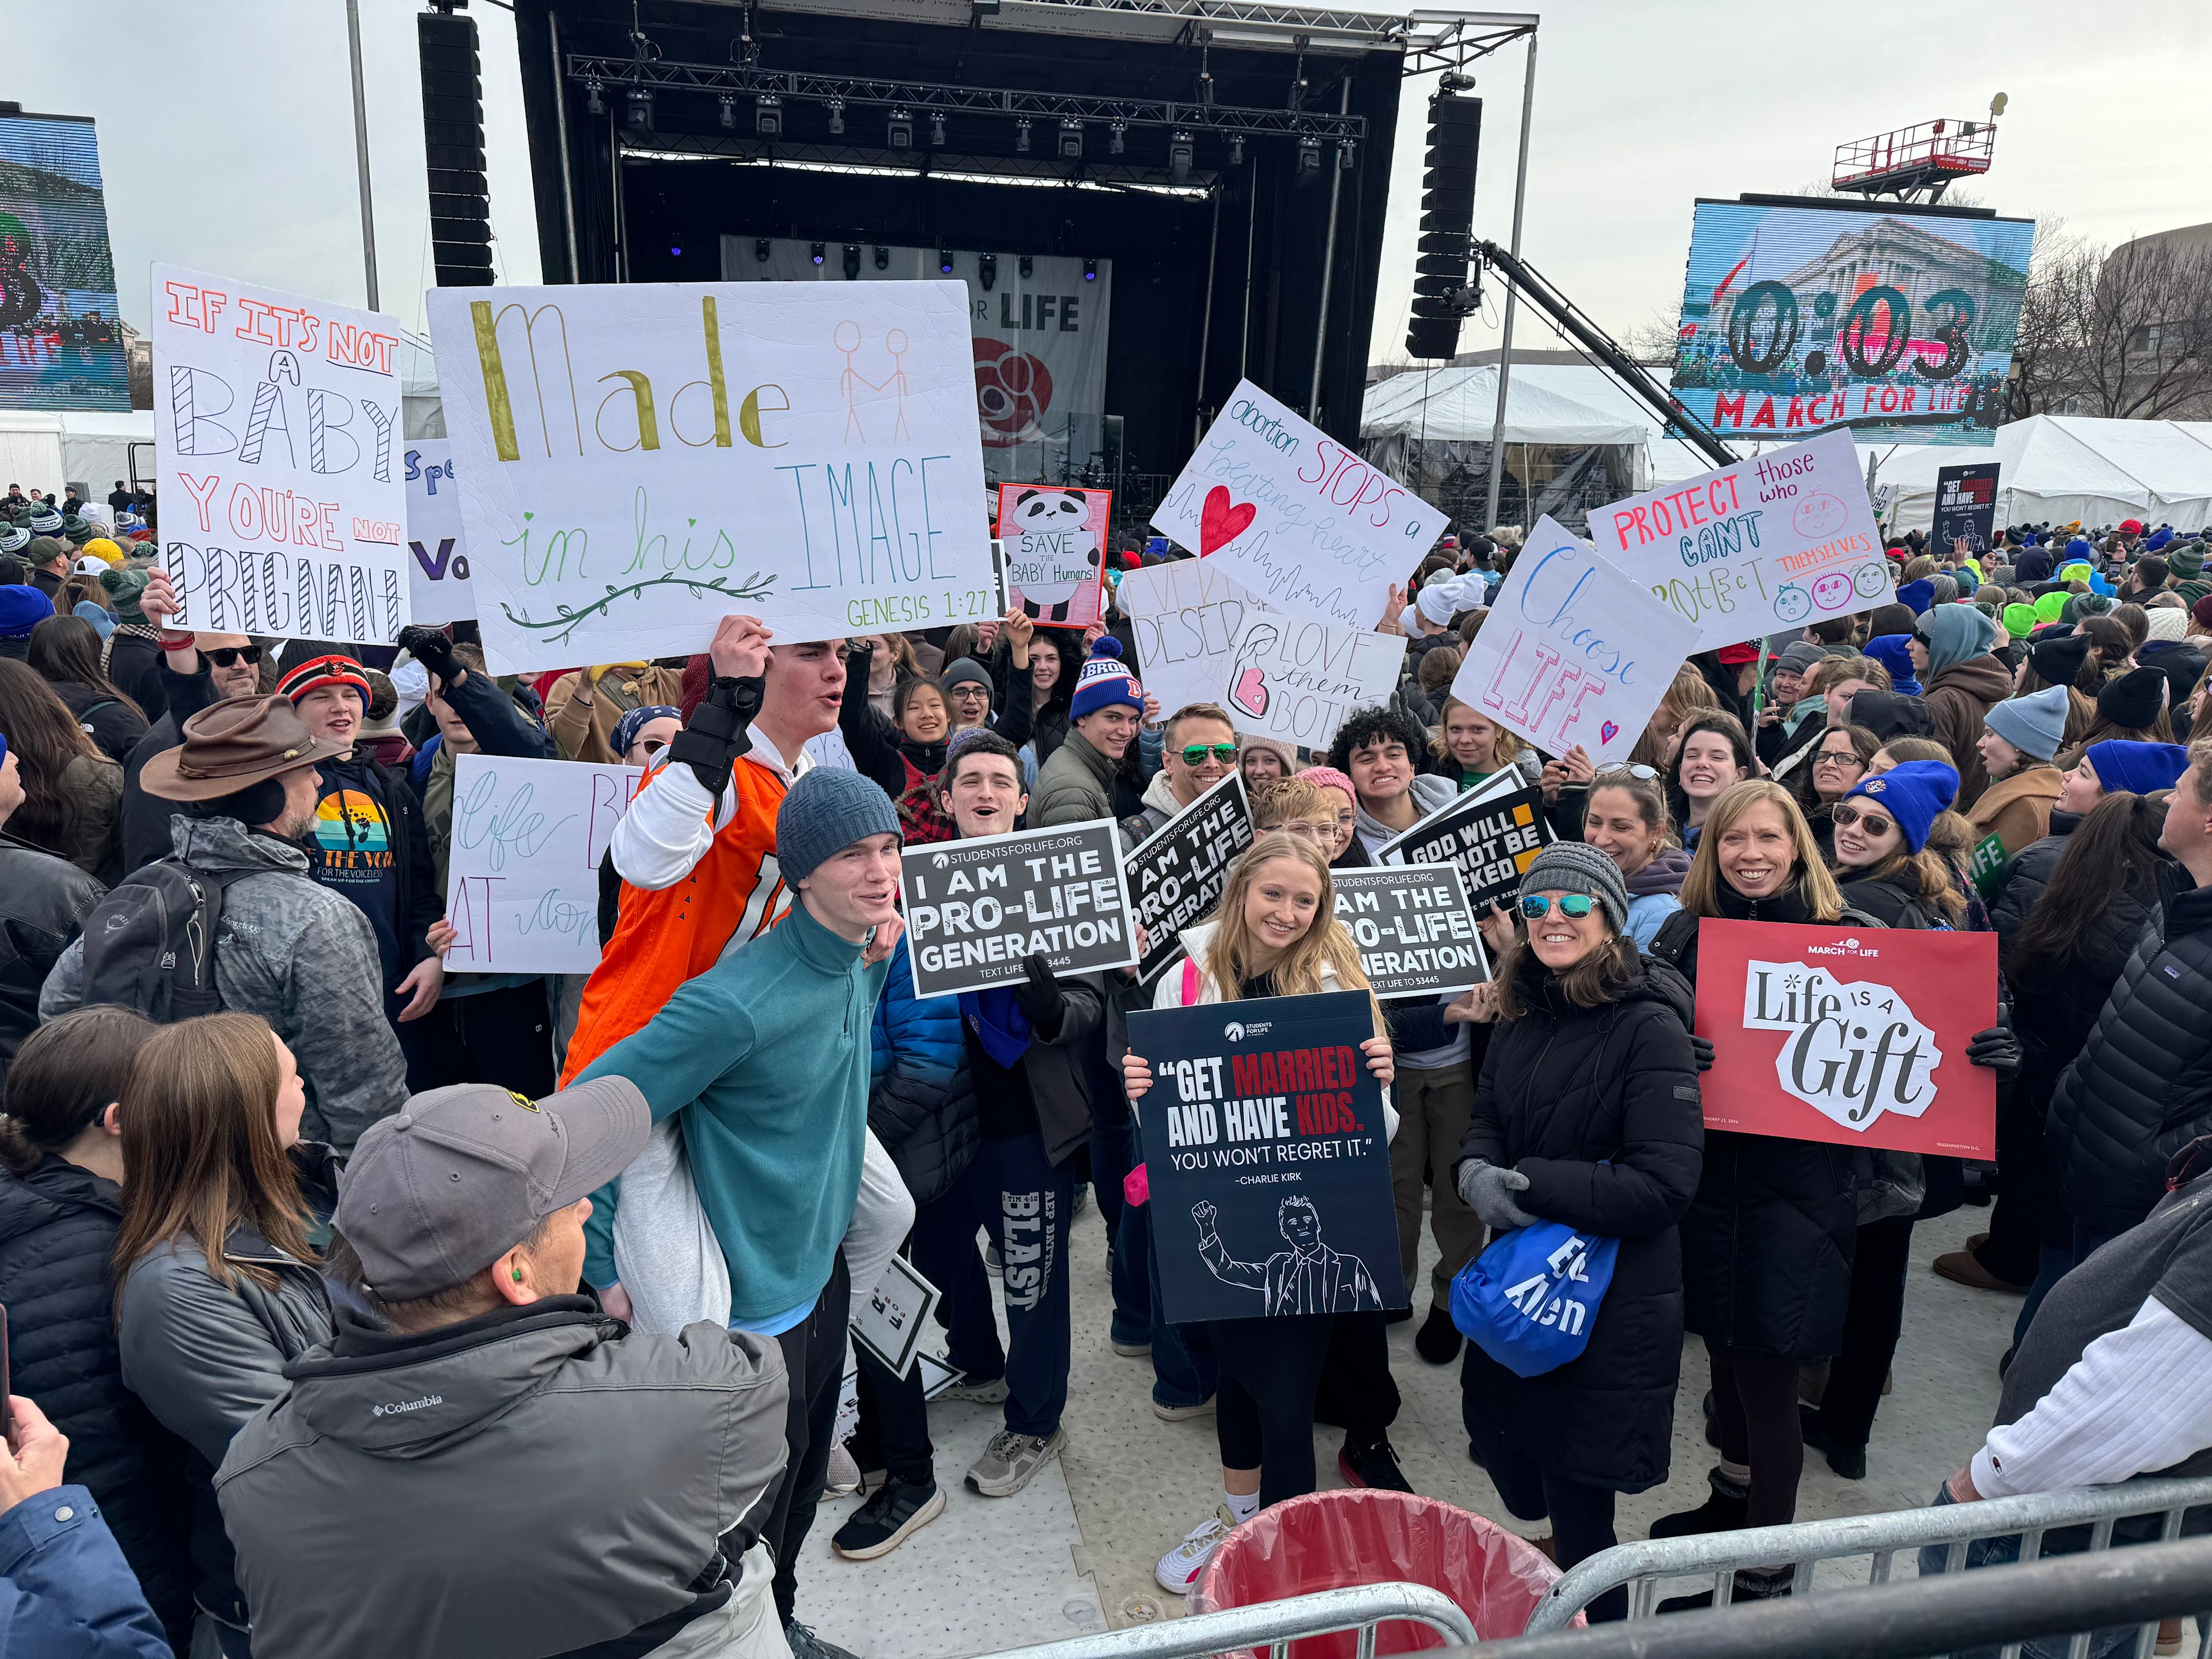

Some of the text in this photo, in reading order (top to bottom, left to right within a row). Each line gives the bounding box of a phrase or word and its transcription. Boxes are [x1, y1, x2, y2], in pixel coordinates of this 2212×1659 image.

[166, 281, 398, 373] IF IT'S NOT
[1001, 293, 1079, 332] LIFE
[1729, 280, 1976, 379] 0:03
[268, 350, 300, 386] A
[469, 296, 790, 461] Made
[171, 365, 397, 482] BABY
[1713, 390, 1847, 429] MARCH
[1863, 386, 1916, 414] FOR
[1231, 400, 1421, 539] abortion STOPS a
[178, 472, 399, 552] YOU'RE NOT
[1204, 441, 1386, 582] beating heart
[1613, 452, 1815, 551] PROTECT those
[1759, 484, 1798, 504] who
[1941, 493, 1956, 506] AND
[1957, 491, 1974, 504] HAVE
[501, 486, 735, 585] in his
[775, 455, 956, 591] IMAGE
[1021, 533, 1074, 554] SAVE
[1679, 510, 1763, 567] CANT
[1012, 563, 1046, 582] BABY
[1054, 564, 1096, 581] Humans!
[1775, 532, 1870, 572] THEMSELVES
[847, 590, 987, 628] GENESIS 1:27
[1521, 541, 1634, 684] Choose
[1279, 620, 1374, 682] LOVE
[1268, 665, 1385, 701] them
[1483, 628, 1606, 755] LIFE
[950, 835, 1083, 864] STUDENTSFORLIFE.ORG
[1138, 794, 1221, 866] STUDENTSFORLIFE.ORG
[1141, 799, 1237, 893] AM THE
[1411, 811, 1514, 864] GOD WILL
[1503, 824, 1540, 854] BE
[317, 866, 383, 878] FOR THE VOICELESS
[324, 850, 359, 868] THE
[915, 849, 1103, 899] I AM THE
[1333, 873, 1434, 888] STUDENTSFORLIFE.ORG
[1464, 855, 1515, 896] CKED
[1968, 840, 2002, 878] IFE
[448, 876, 506, 963] AT
[909, 877, 1121, 941] PRO-LIFE
[1334, 886, 1453, 914] AM THE
[1479, 895, 1499, 907] ROSE
[920, 916, 1121, 972] GENERATION
[1361, 945, 1477, 976] NERATION
[1808, 945, 1845, 956] MARCH
[1859, 948, 1879, 957] LIFE
[980, 956, 1071, 979] TEXT LIFE 3445
[1388, 979, 1402, 988] LIFE
[1404, 978, 1415, 986] TO
[1416, 976, 1439, 985] 53445
[1753, 971, 1894, 1024] Life IS A
[1232, 1046, 1357, 1097] MARRIED
[1791, 1017, 1927, 1122] Gift
[1167, 1092, 1364, 1147] AND HAVE KIDS.
[1171, 1152, 1209, 1172] YOU
[1277, 1140, 1342, 1162] REGRET
[1235, 1171, 1302, 1185] -CHARLIE KIRK
[1002, 1191, 1041, 1312] BLAST
[384, 1395, 443, 1414] Columbia
